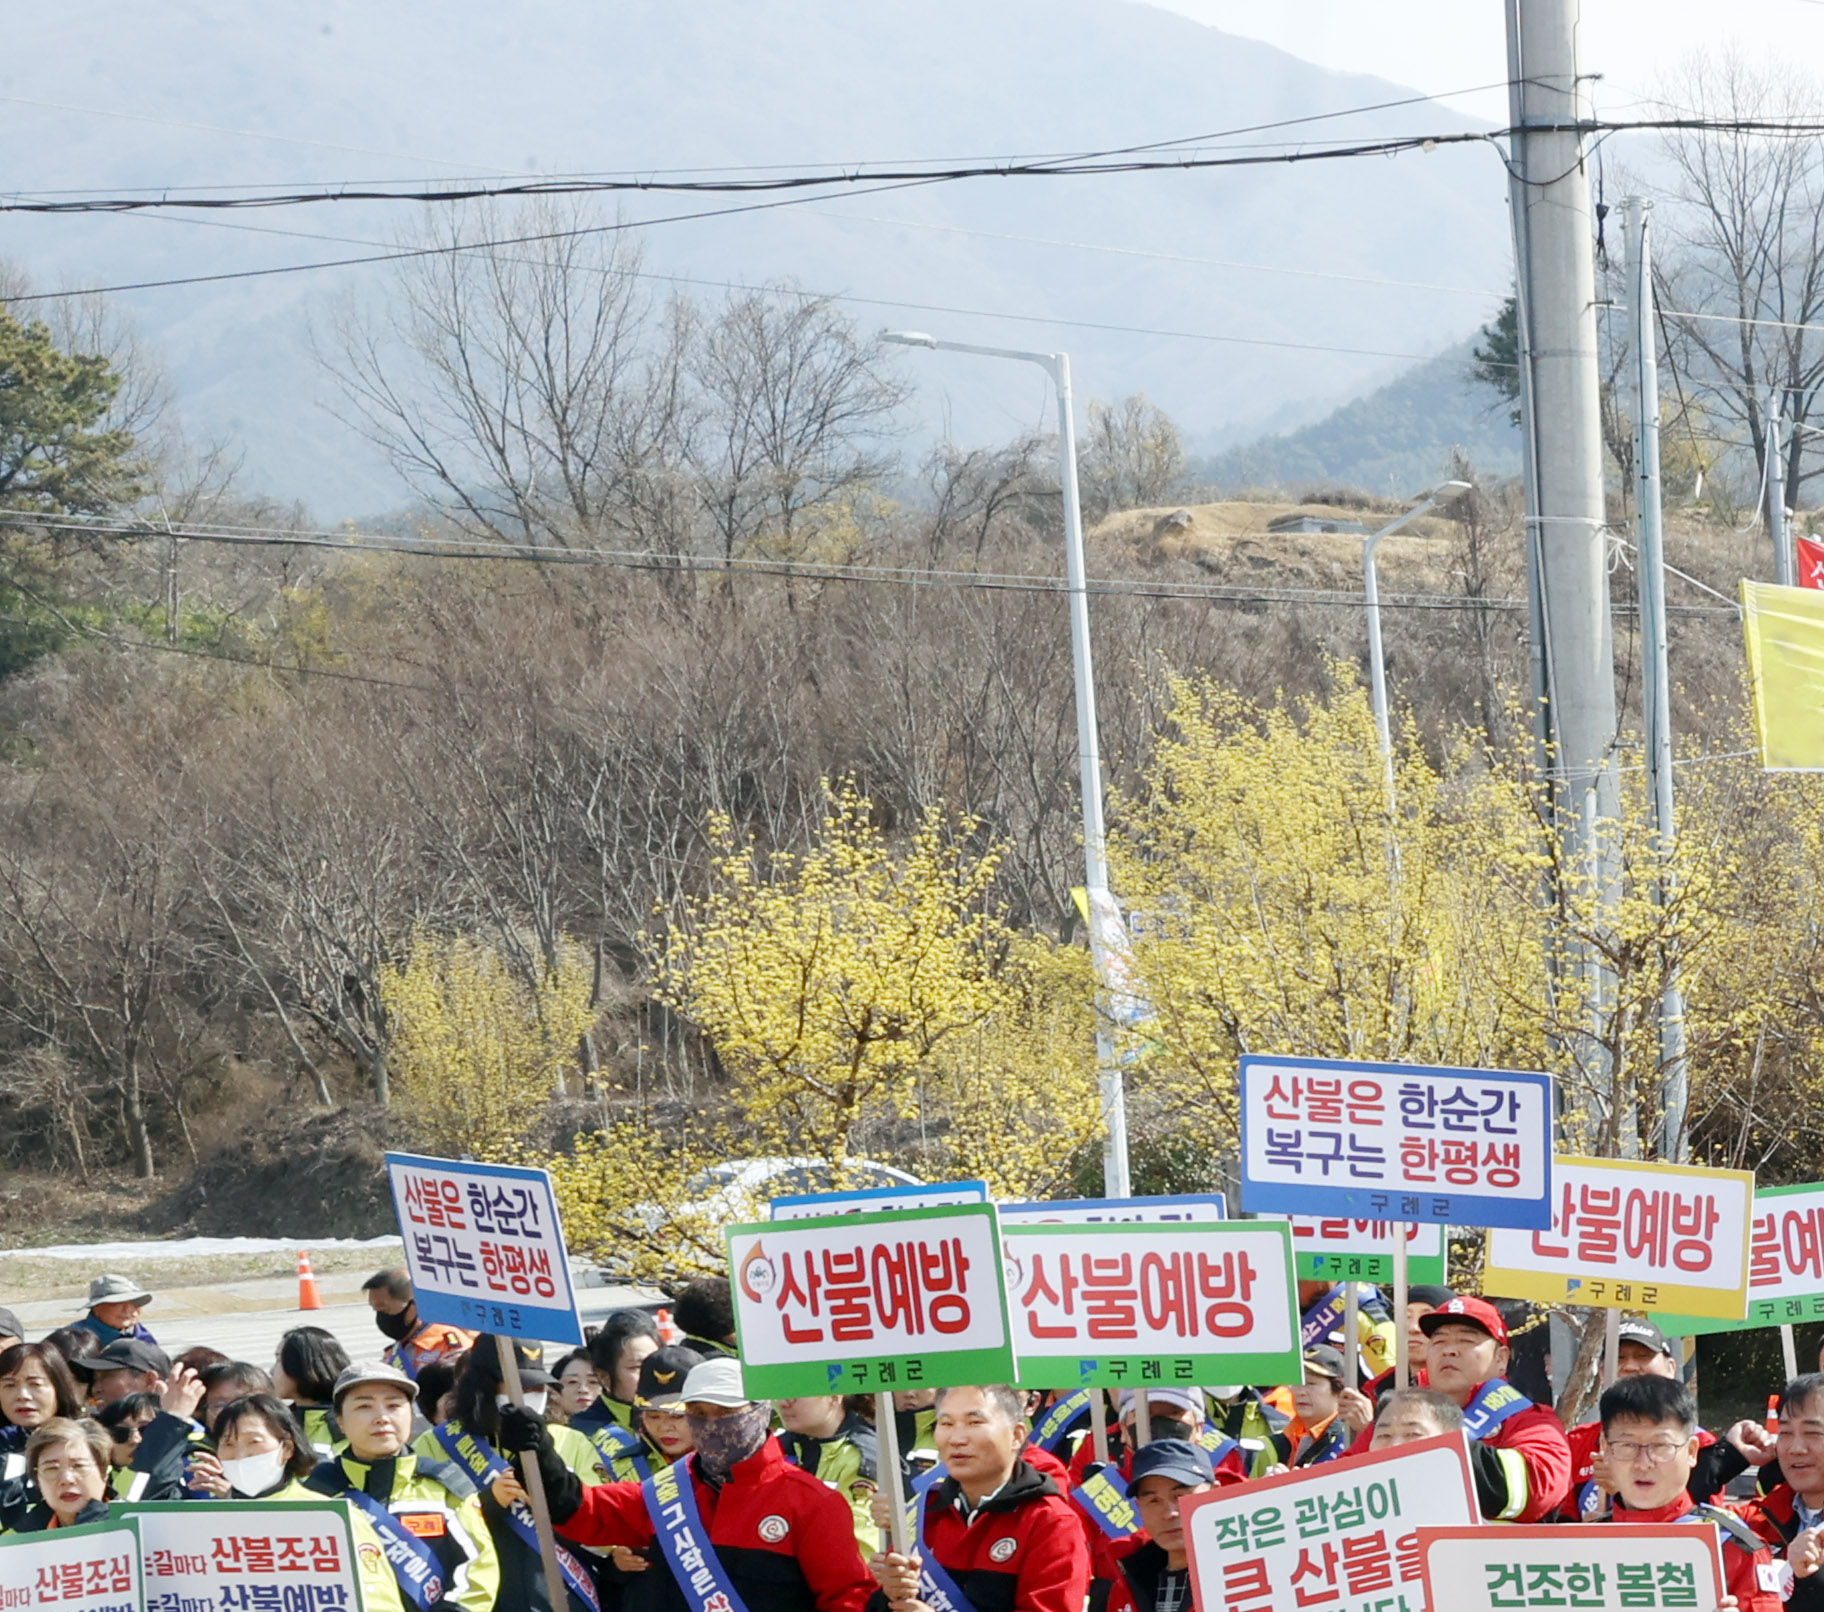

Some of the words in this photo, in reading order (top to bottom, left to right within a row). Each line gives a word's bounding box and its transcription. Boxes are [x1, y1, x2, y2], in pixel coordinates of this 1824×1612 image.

[1263, 1074, 1384, 1126] 산불은
[1399, 1081, 1521, 1134] 한순간
[1264, 1128, 1386, 1180] 복구는
[1399, 1134, 1521, 1189] 한평생
[405, 1174, 466, 1230] 산불은
[467, 1184, 541, 1241] 한순간
[1371, 1194, 1450, 1217] 구례군
[1531, 1183, 1720, 1272] 산불예방
[415, 1233, 477, 1289] 복구는
[480, 1241, 556, 1298] 한평생
[777, 1237, 971, 1344] 산불예방
[1022, 1251, 1257, 1339] 산불예방
[1330, 1257, 1380, 1275] 구례군
[1589, 1280, 1658, 1306] 구례군
[852, 1360, 923, 1385] 구례군
[1110, 1360, 1194, 1380] 구례군
[1214, 1507, 1286, 1553] 작은
[1293, 1478, 1401, 1536] 관심이
[35, 1554, 131, 1603] 산불조심
[211, 1536, 341, 1574] 산불조심
[673, 1527, 717, 1596] 시작은
[1485, 1563, 1606, 1608] 건조한
[1616, 1561, 1698, 1608] 봄철
